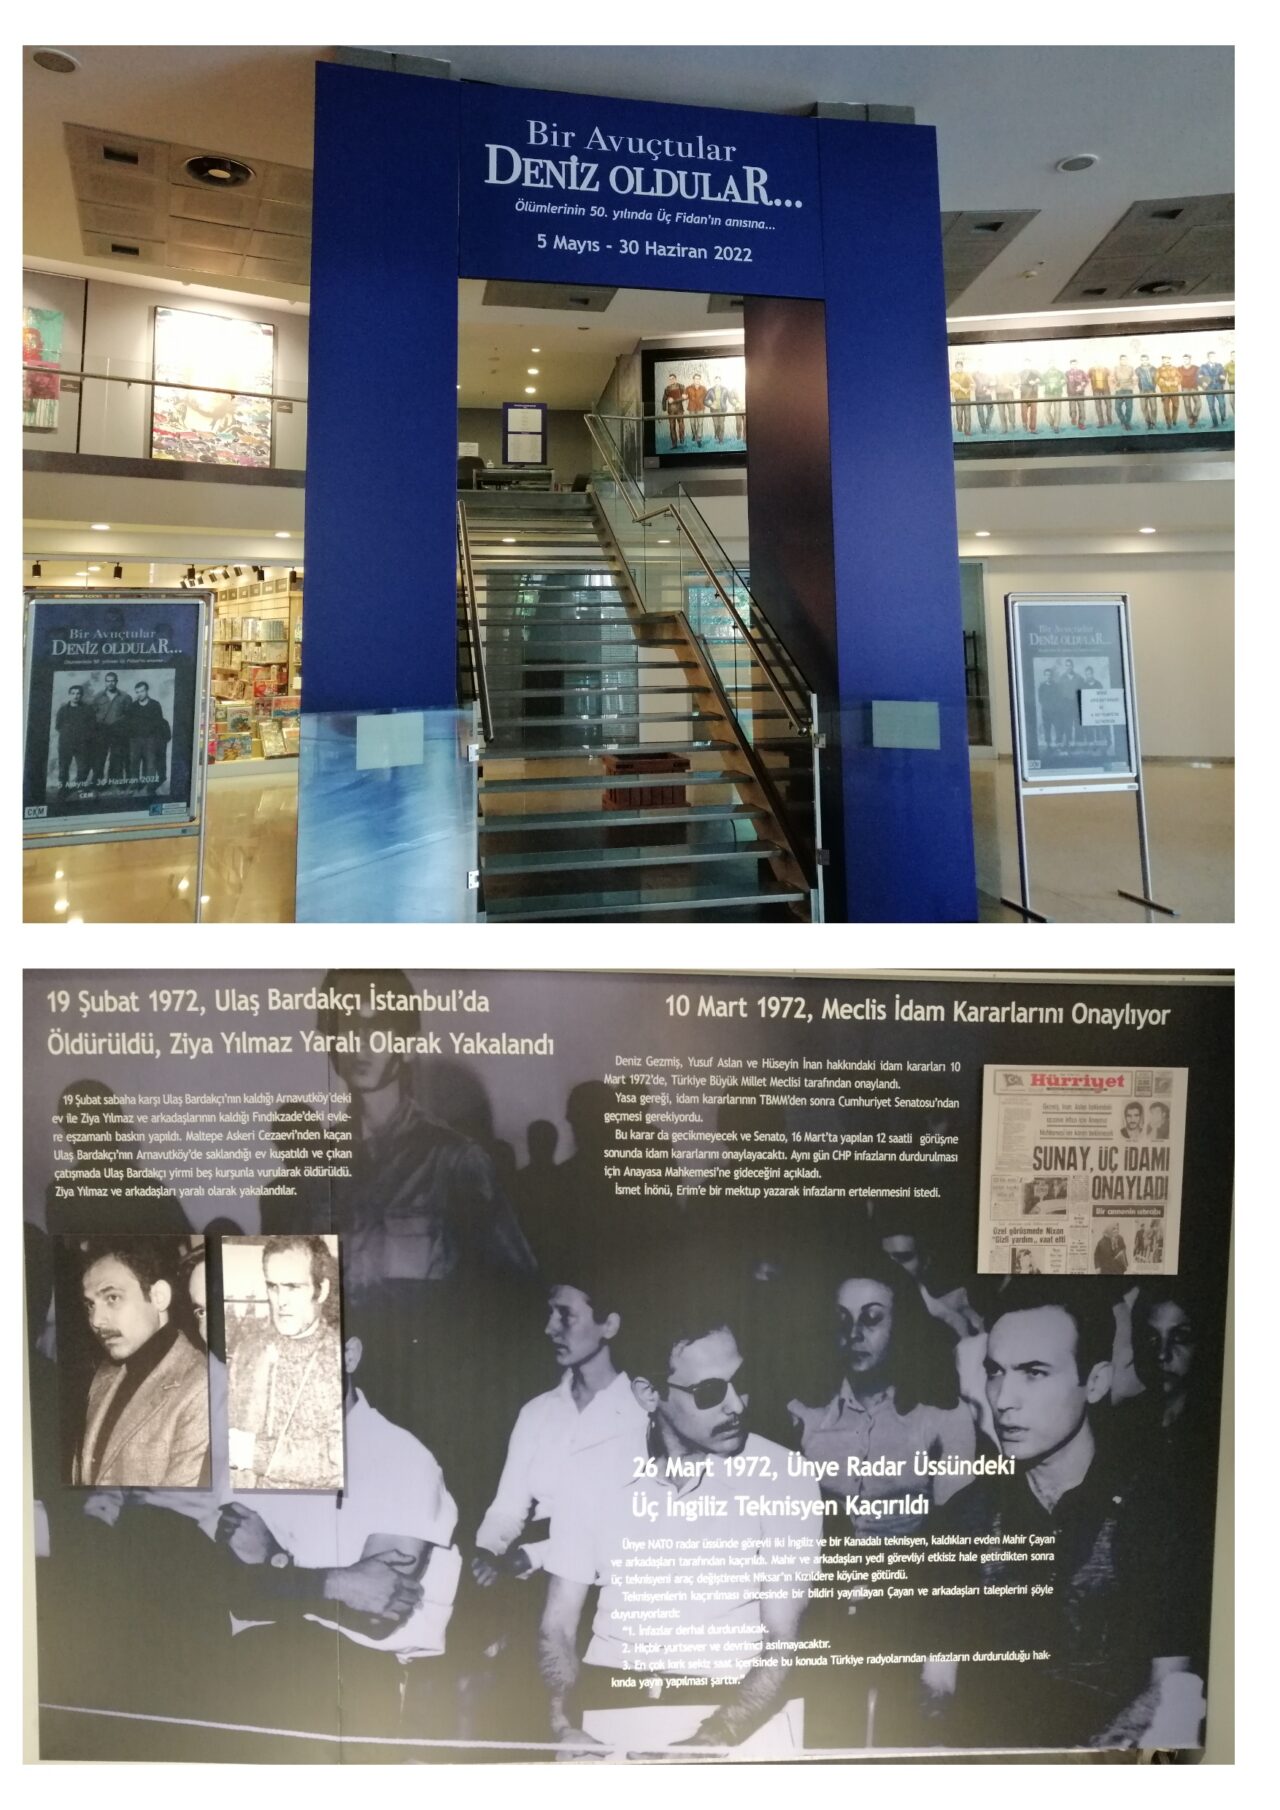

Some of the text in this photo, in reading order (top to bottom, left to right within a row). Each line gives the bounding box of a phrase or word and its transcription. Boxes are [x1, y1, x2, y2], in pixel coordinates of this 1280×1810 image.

[526, 119, 737, 162] Bir Avuçtular
[484, 143, 803, 208] DENİZ OLDULAR...
[515, 197, 585, 215] Ölümlerinin
[590, 205, 607, 217] 50.
[612, 208, 652, 220] yılında
[657, 207, 671, 224] Üç
[725, 217, 774, 230] anısına...
[538, 232, 546, 248] 5
[553, 234, 599, 254] Mayıs
[619, 238, 638, 254] 30
[646, 240, 707, 259] Haziran
[714, 245, 752, 262] 2022
[70, 629, 89, 639] Bir
[52, 640, 98, 655] DENİZ
[27, 807, 46, 817] CKM
[47, 990, 70, 1011] 19
[78, 990, 139, 1017] Şubat
[149, 989, 205, 1014] 1972,
[215, 989, 259, 1015] Ulaş
[268, 988, 362, 1015] Bardakçı
[666, 994, 1170, 1029] 10 Mart 1972, Meclis İdam Kararlarını Onaylıyor
[47, 1028, 553, 1058] Öldürüldü, Ziya Yılmaz Yaralı Olarak Yakalandı
[615, 1054, 960, 1072] Deniz Gezmiş, Yusuf Aslan ve Hüseyin İnan hakkındaki idam kararları 10
[1030, 1074, 1125, 1093] Hürriyet
[53, 1132, 62, 1142] re
[66, 1130, 112, 1144] eşzamanlı
[115, 1130, 144, 1142] baskın
[148, 1130, 181, 1143] yapıldı.
[186, 1130, 223, 1143] Maltepe
[226, 1129, 254, 1141] Askeri
[323, 1128, 351, 1142] kaçan
[615, 1128, 627, 1140] Bu
[630, 1128, 654, 1140] karar
[657, 1129, 668, 1140] da
[672, 1129, 737, 1143] gecikmeyecek
[740, 1132, 751, 1141] ve
[754, 1130, 787, 1143] Senato,
[792, 1130, 801, 1142] 16
[840, 1132, 873, 1145] yapılan
[876, 1131, 886, 1143] 12
[888, 1132, 912, 1144] saatli
[920, 1132, 958, 1146] görüşme
[1033, 1146, 1170, 1173] SUNAY, ÜÇ İDAMI
[55, 1184, 296, 1199] Ziya Yılmaz ve arkadaşları yaralı olarak yakalandılar.
[615, 1181, 640, 1195] İsmet
[644, 1182, 672, 1197] İnönü,
[709, 1184, 722, 1196] bir
[725, 1184, 760, 1198] mektup
[763, 1185, 799, 1198] yazarak
[802, 1185, 845, 1197] infazların
[848, 1186, 910, 1197] ertelenmesini
[913, 1186, 940, 1198] istedi.
[1092, 1176, 1168, 1200] ONAYLADI
[632, 1447, 1015, 1481] 26 Mart 1972, Ünye Radar Üssündeki
[632, 1491, 928, 1522] Üç İngiliz Teknisyen Kaçırıldı
[829, 1531, 1055, 1547] bir Kanadalı teknisyen, kaldıkları evden Mahir Çayan
